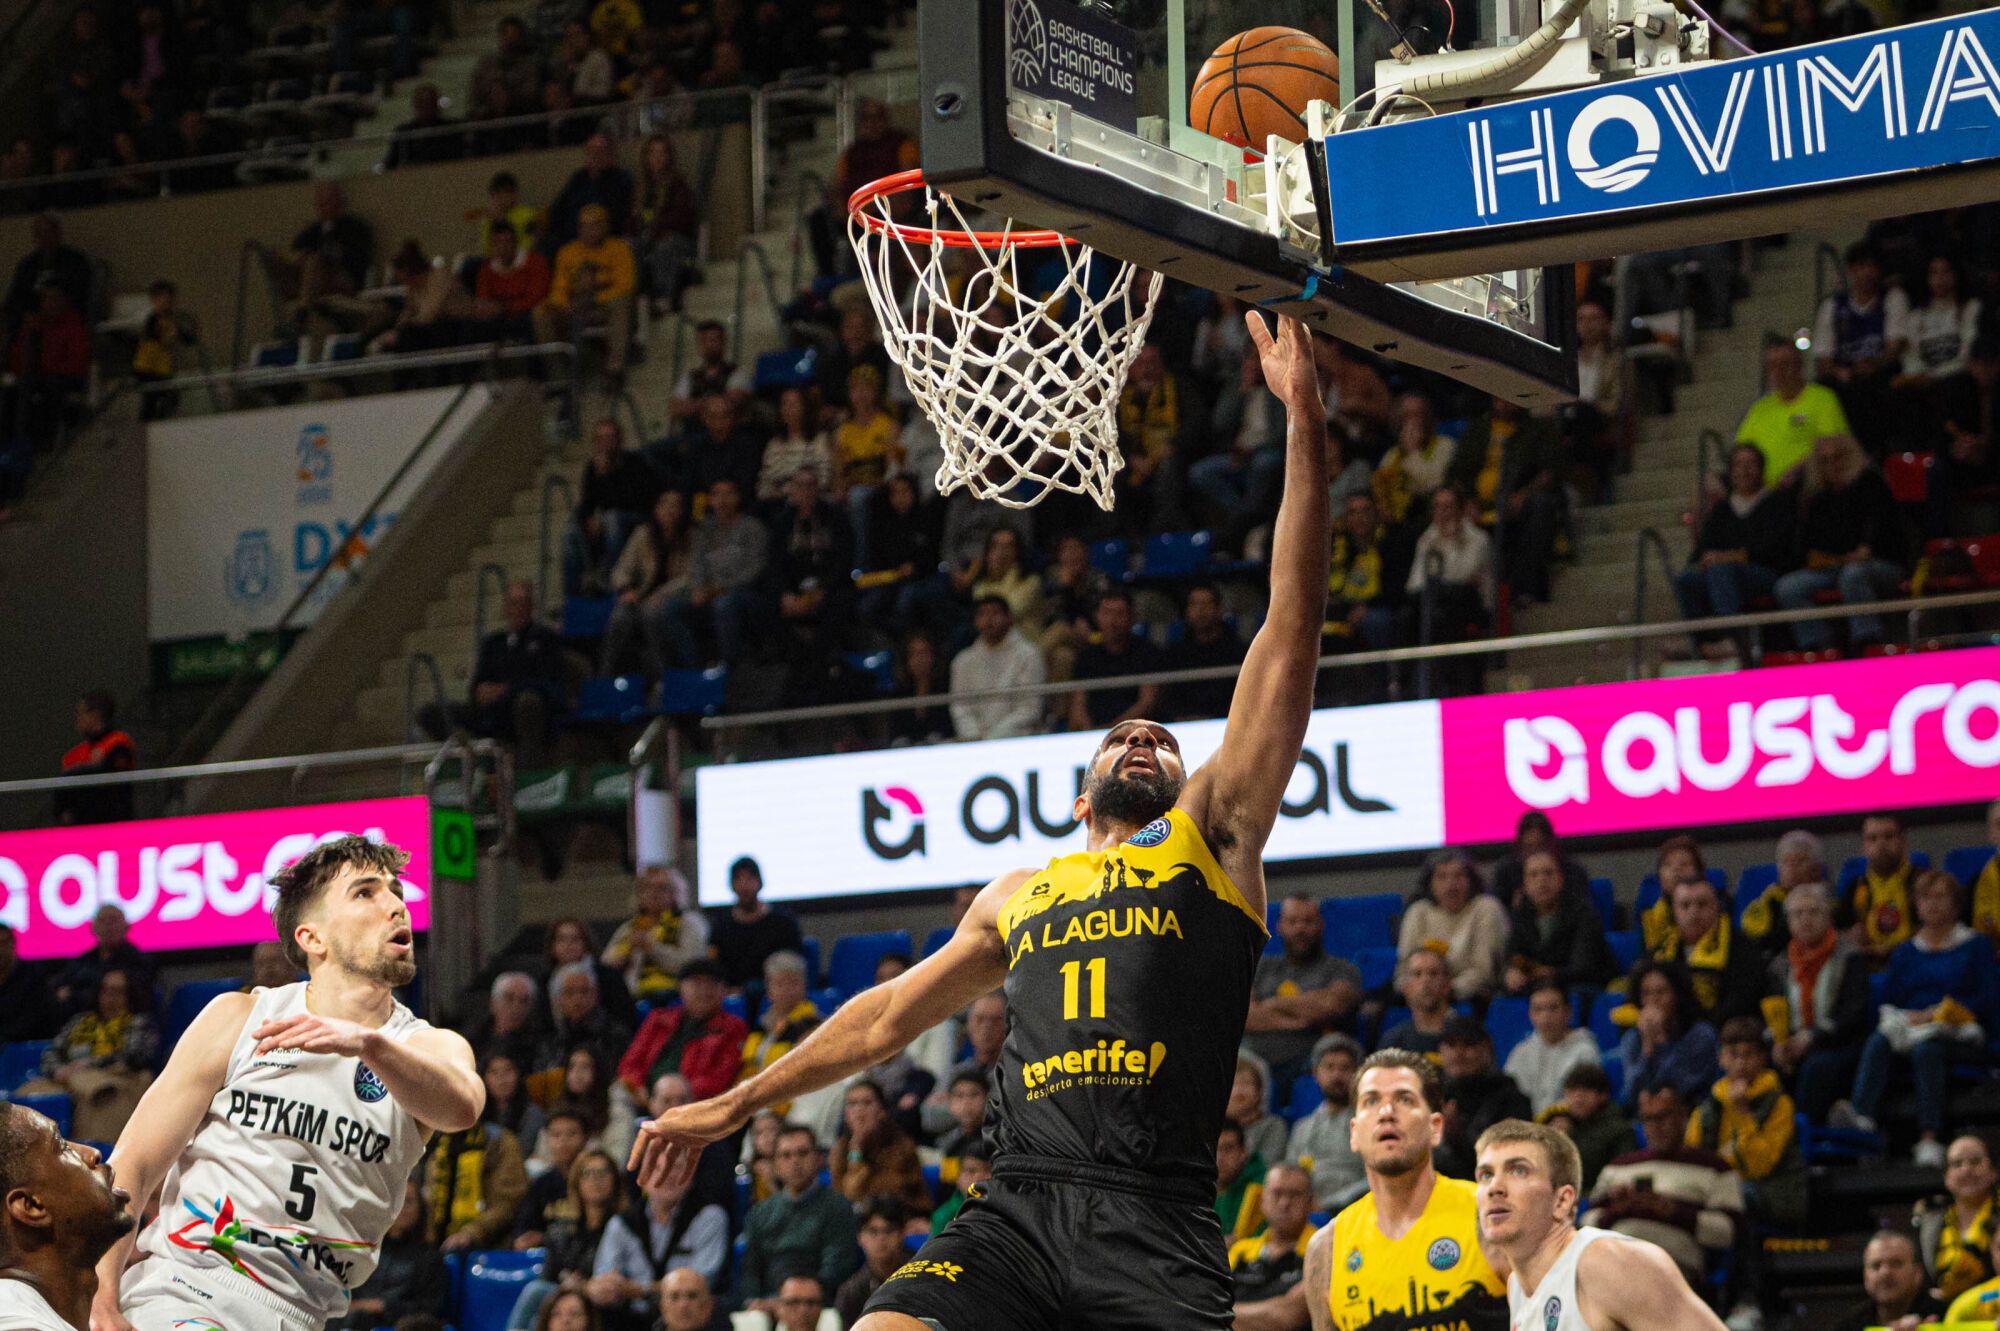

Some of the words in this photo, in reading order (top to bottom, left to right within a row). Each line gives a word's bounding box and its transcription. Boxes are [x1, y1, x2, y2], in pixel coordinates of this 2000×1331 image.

[1049, 19, 1123, 66] BASKETBALL
[1049, 41, 1133, 95] CHAMPIONS
[1049, 66, 1096, 102] LEAGUE
[1468, 26, 2000, 217] HOVIMA
[1009, 930, 1035, 971] LA
[1042, 906, 1184, 948] LAGUNA
[1059, 957, 1106, 1020] 11
[284, 1163, 319, 1222] 5
